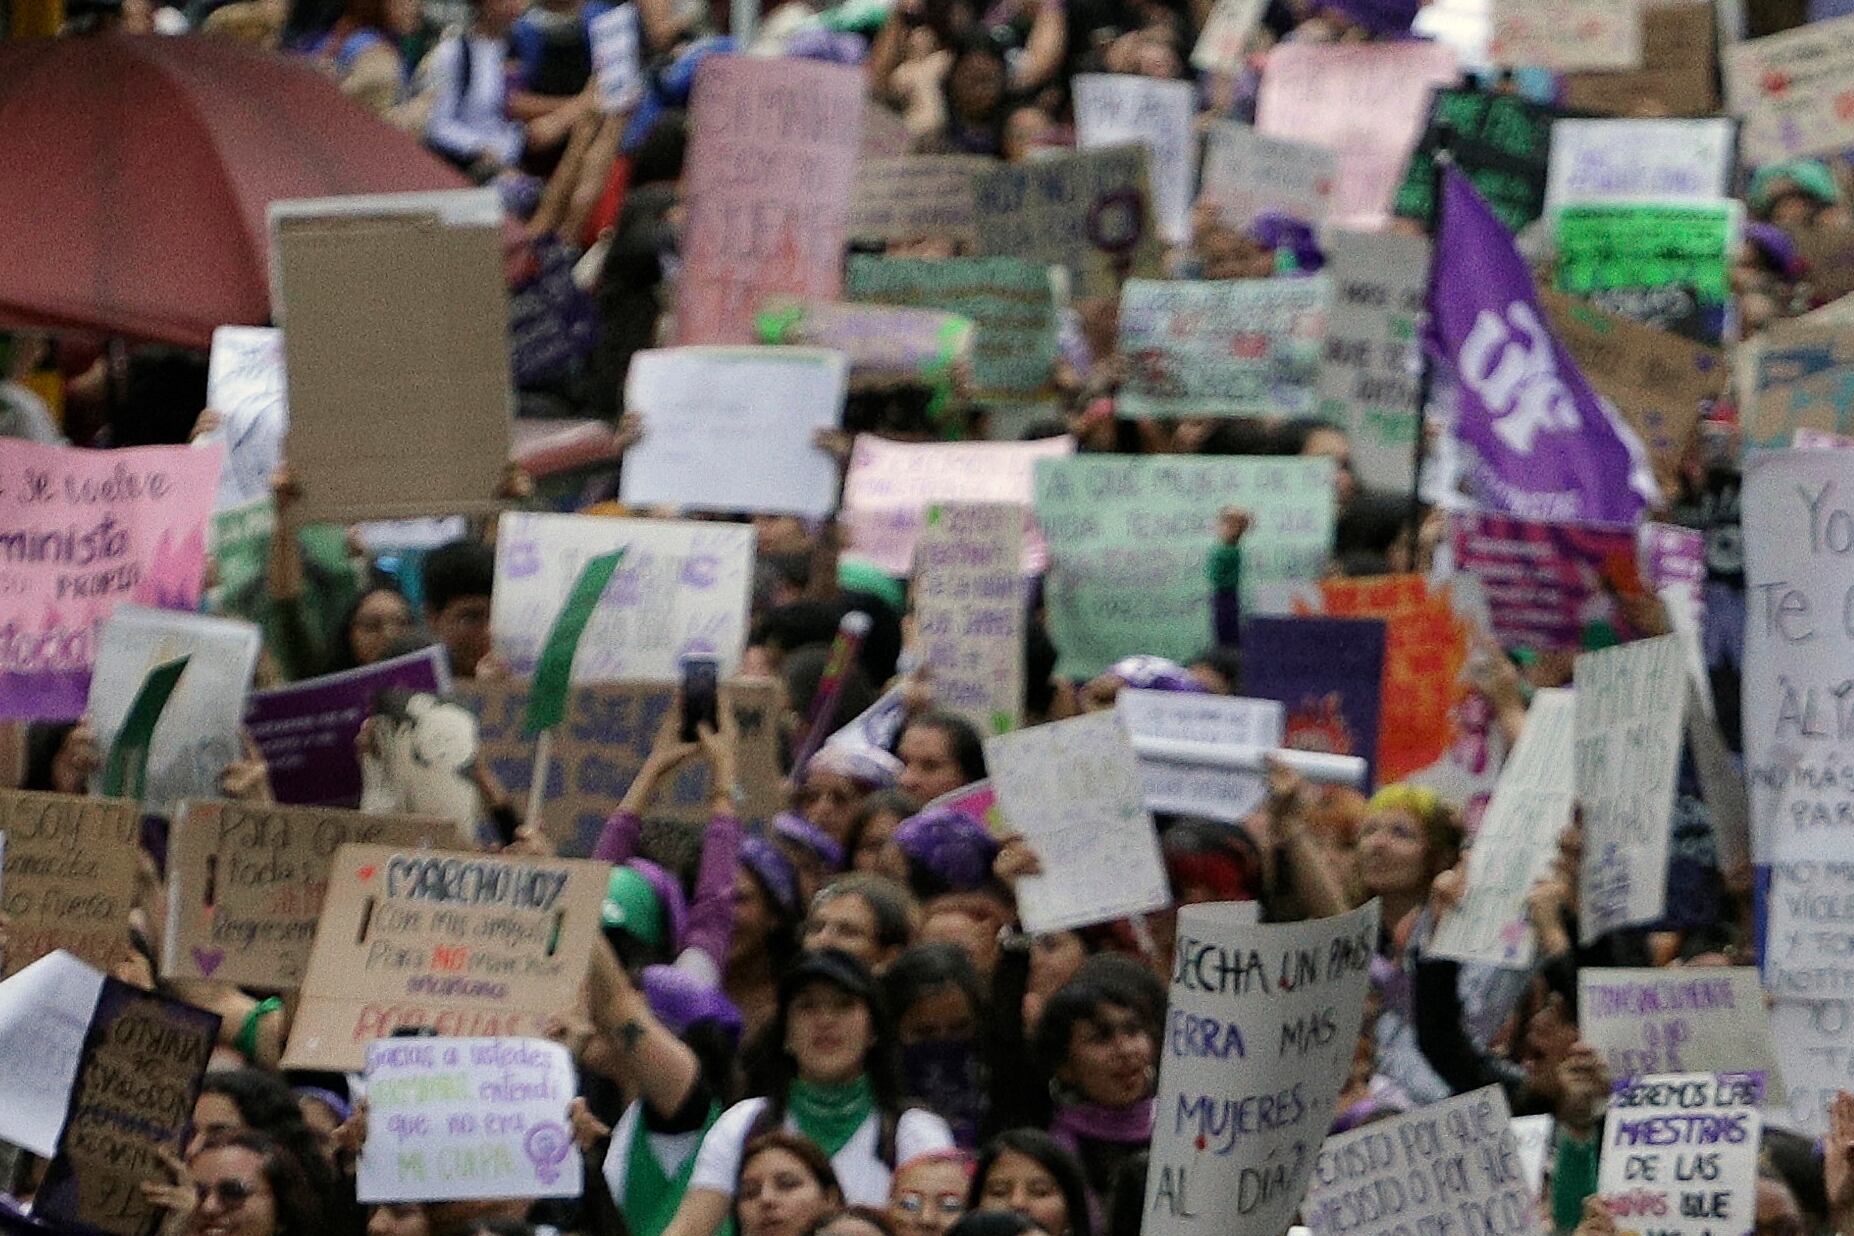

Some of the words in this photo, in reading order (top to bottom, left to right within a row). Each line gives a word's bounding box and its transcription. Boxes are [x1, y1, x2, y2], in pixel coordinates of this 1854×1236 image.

[1174, 1082, 1305, 1156] MUJERES
[1153, 1164, 1198, 1218] AL
[1624, 1154, 1660, 1182] DE
[1674, 1153, 1722, 1182] LAS
